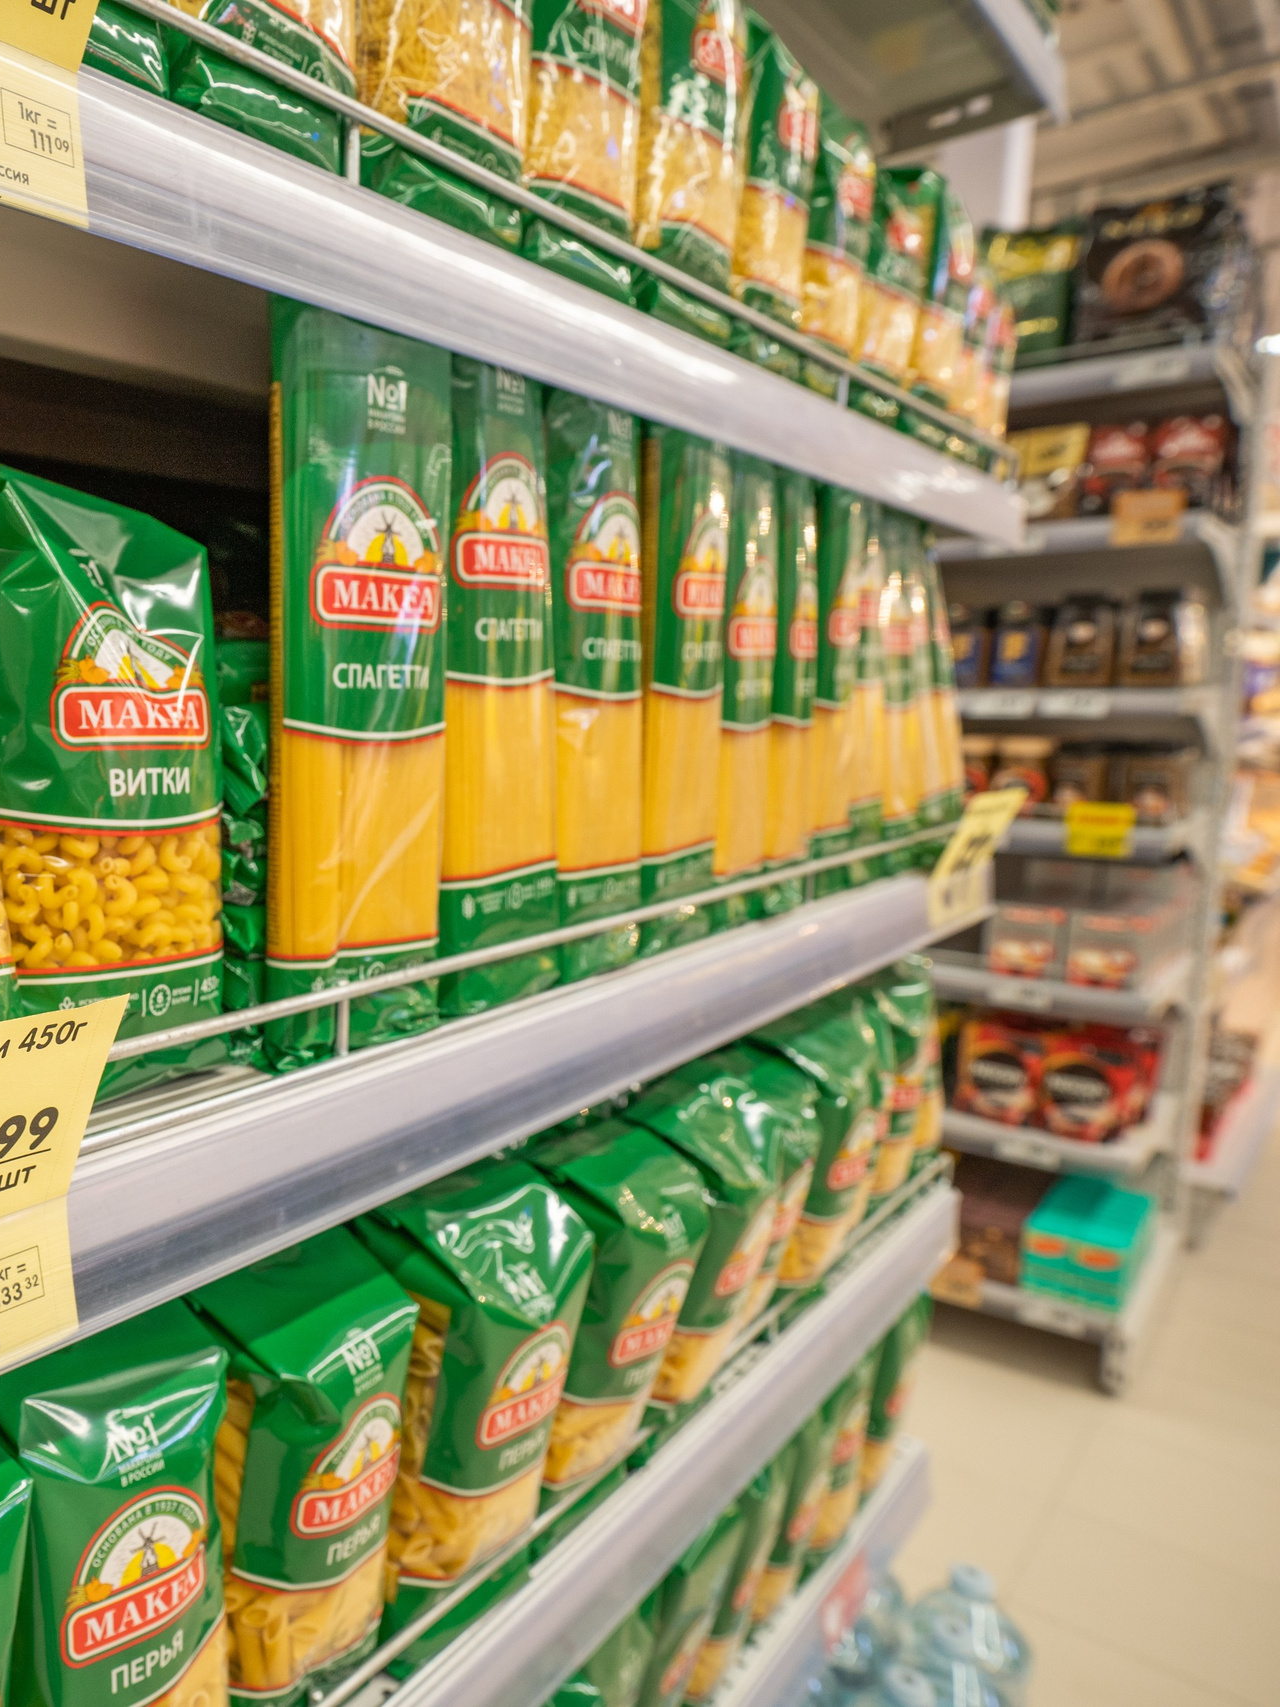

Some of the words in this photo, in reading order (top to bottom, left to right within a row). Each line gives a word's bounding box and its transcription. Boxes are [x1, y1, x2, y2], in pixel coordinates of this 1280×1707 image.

[17, 101, 42, 125] 1кг
[332, 662, 430, 690] СПАГЕТТИ
[109, 766, 191, 797] ВИТКИ
[18, 1018, 89, 1053] 450г
[111, 1628, 184, 1694] ПЕРЬЯ
